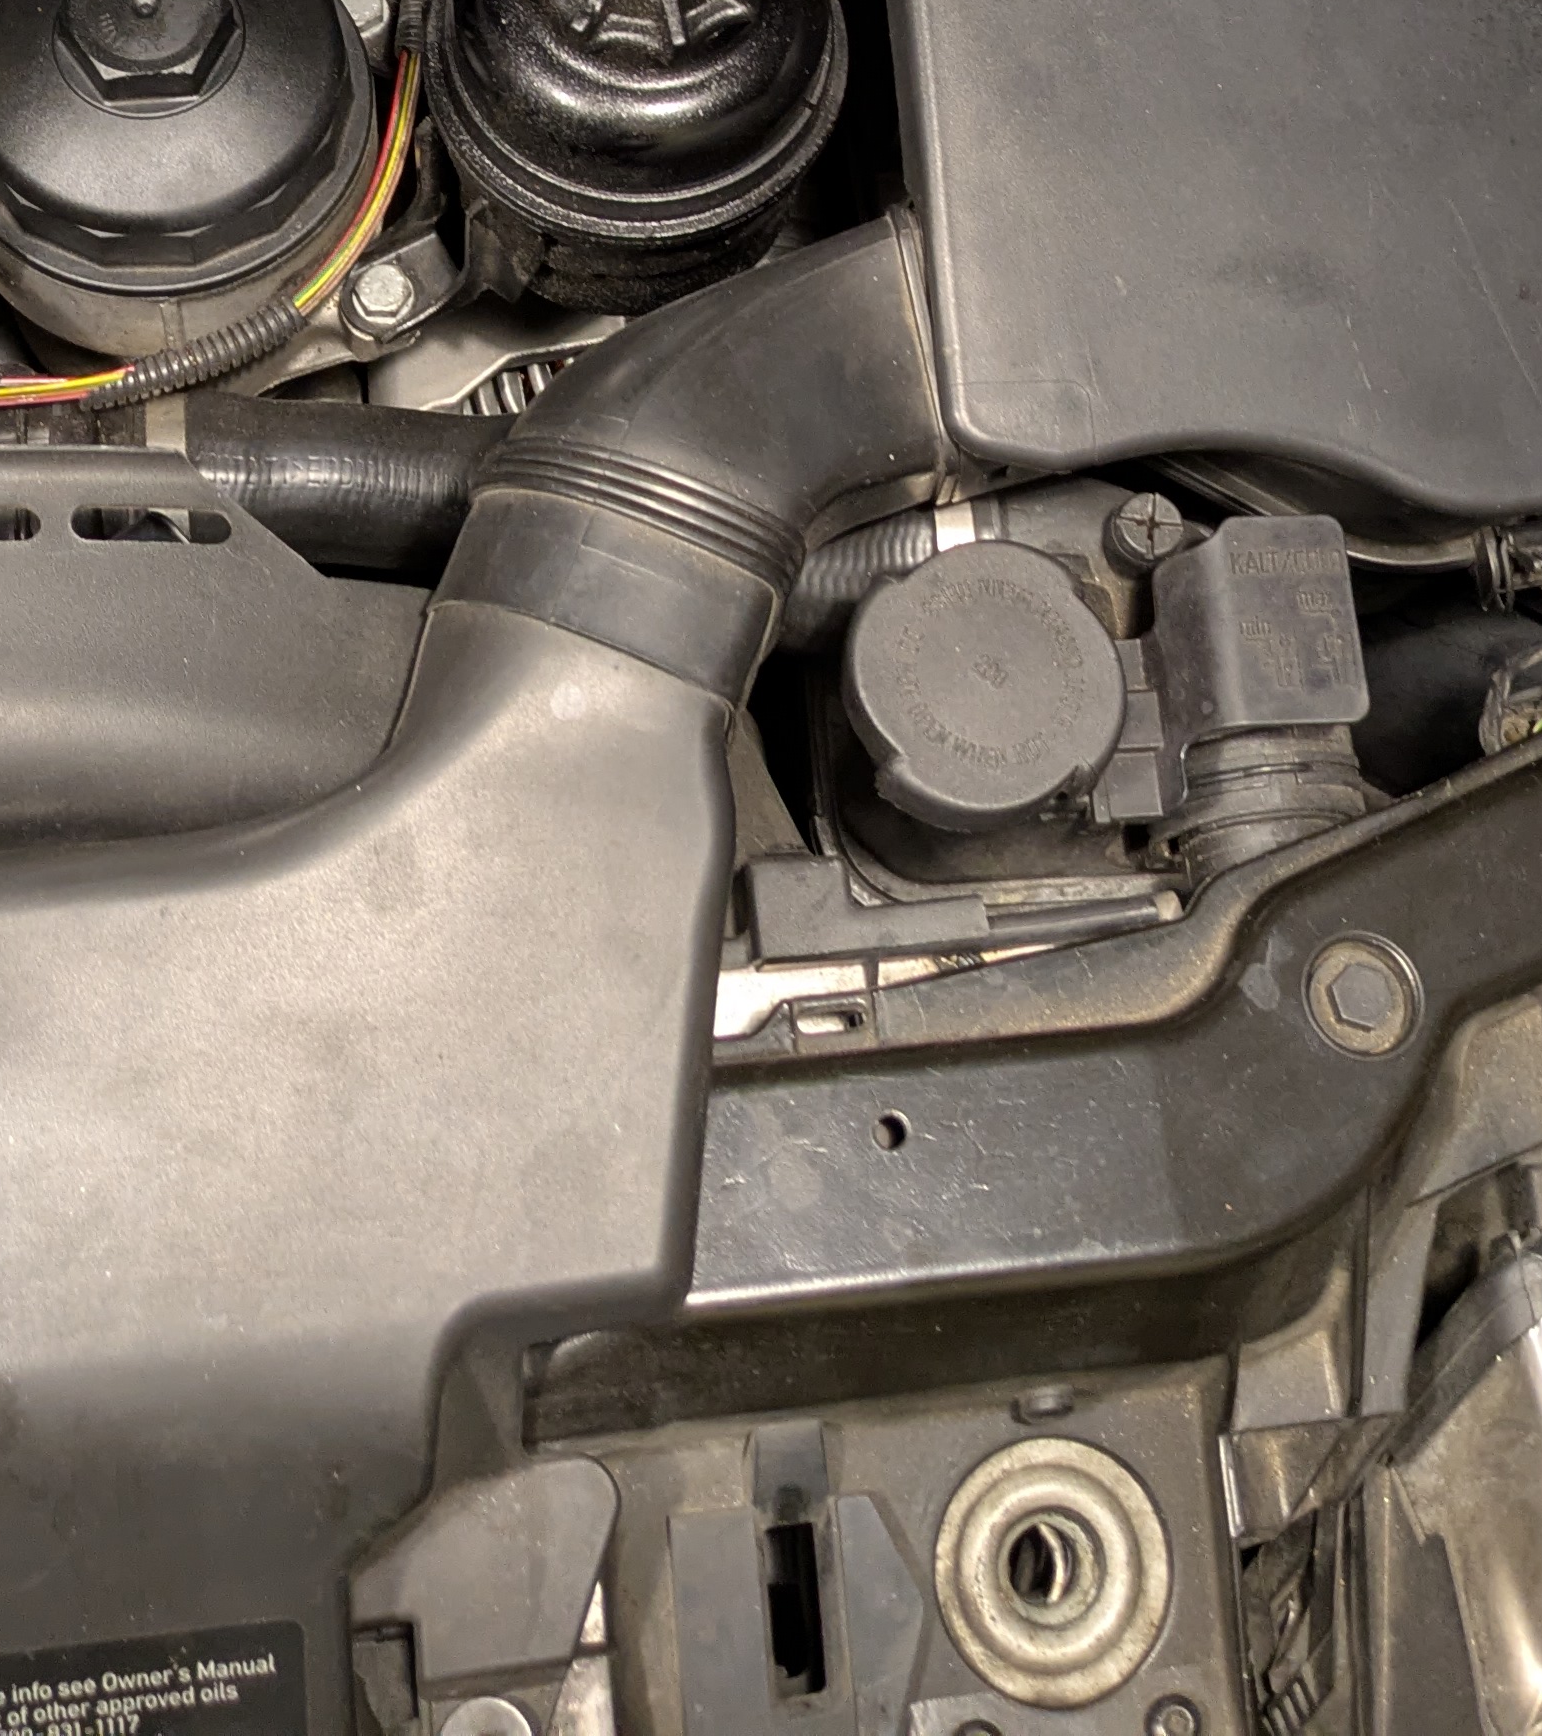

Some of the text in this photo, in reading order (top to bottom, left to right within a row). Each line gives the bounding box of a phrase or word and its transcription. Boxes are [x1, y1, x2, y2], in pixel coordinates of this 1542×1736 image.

[7, 1704, 27, 1726] of
[33, 1698, 90, 1723] other
[96, 1686, 195, 1716] approved
[200, 1681, 239, 1703] oils
[11, 1678, 53, 1706] info
[58, 1677, 97, 1697] see
[102, 1664, 191, 1692] Owner's
[196, 1653, 277, 1681] Manual
